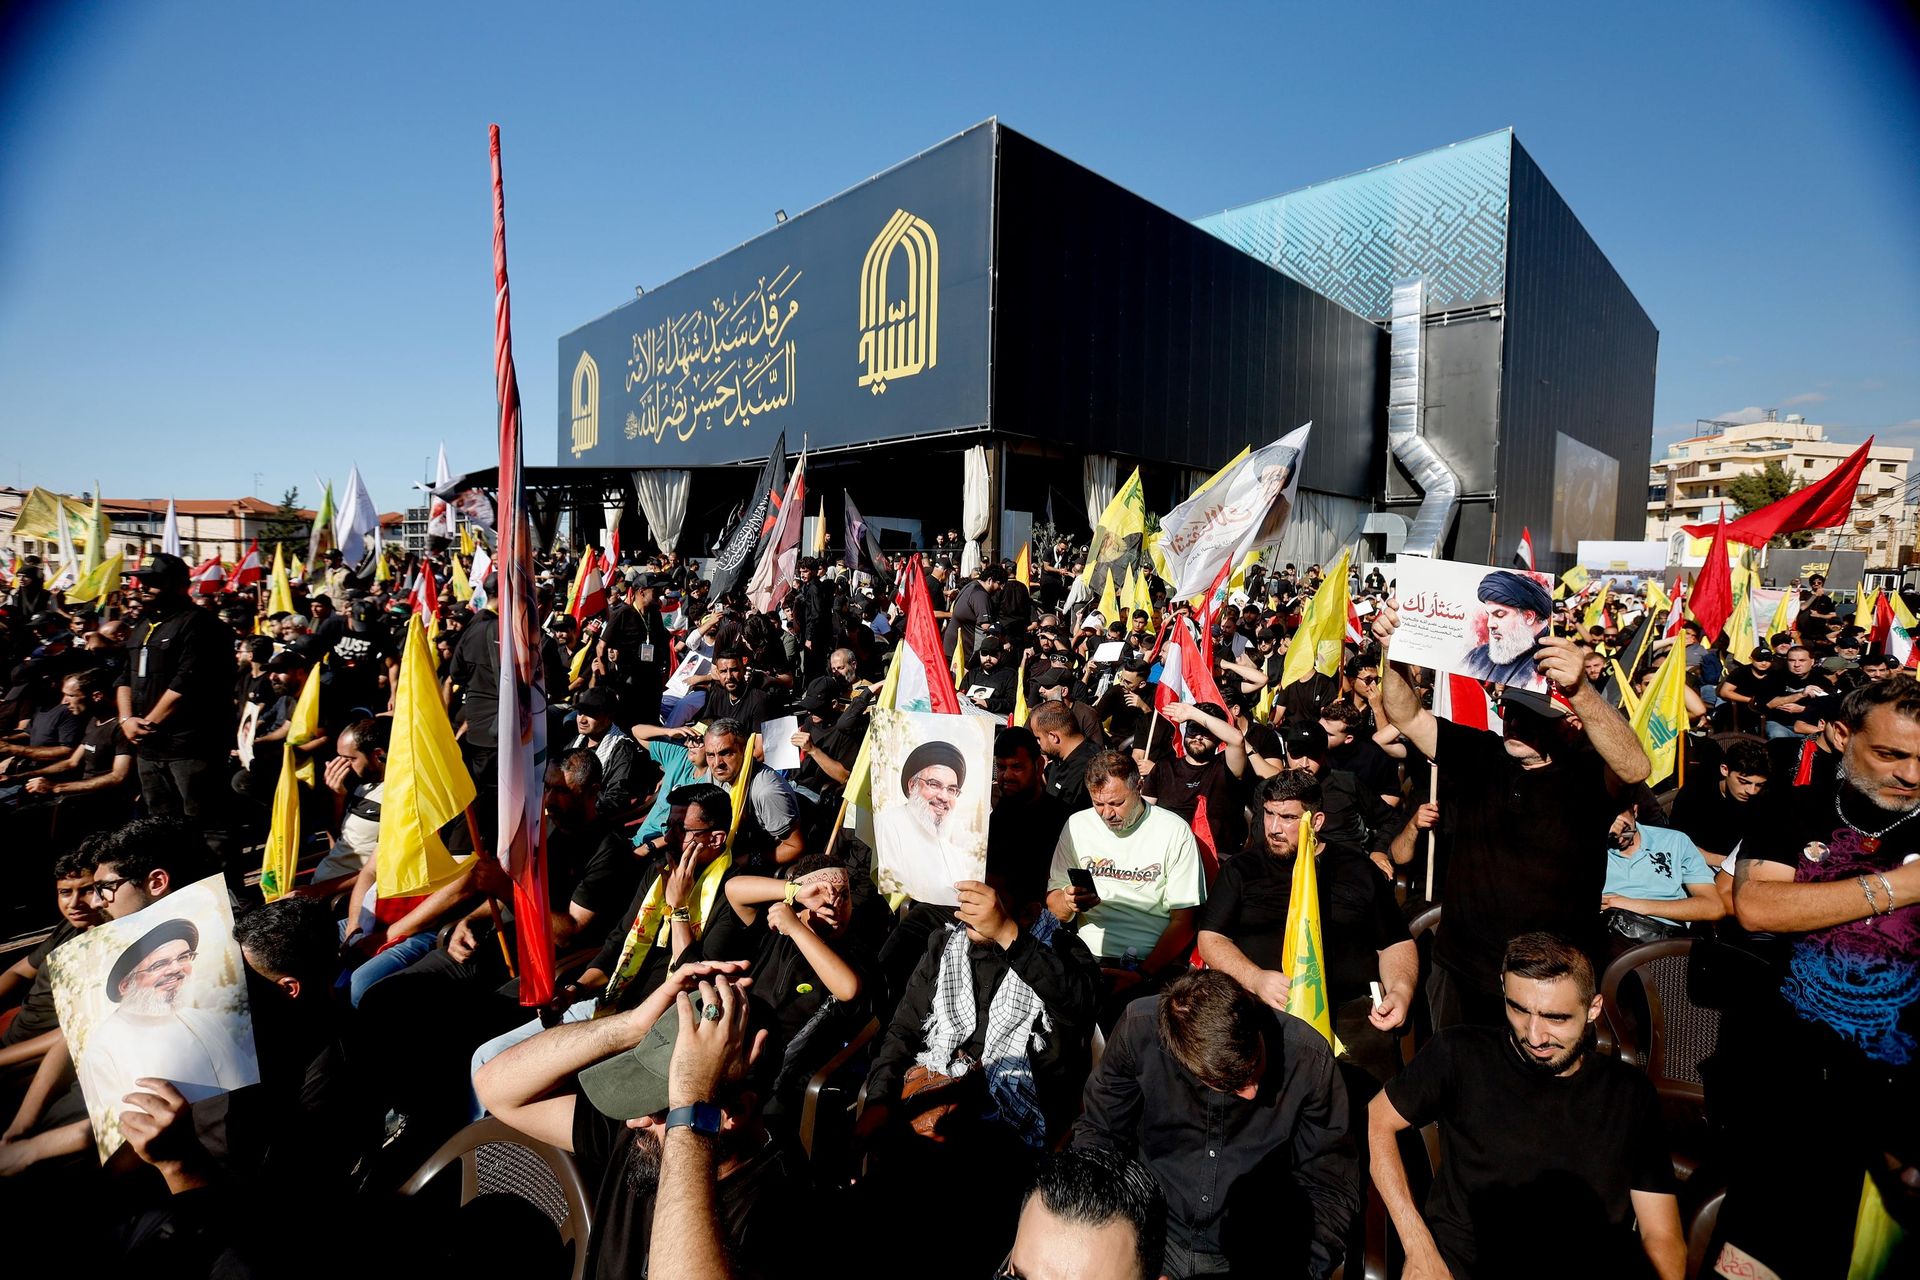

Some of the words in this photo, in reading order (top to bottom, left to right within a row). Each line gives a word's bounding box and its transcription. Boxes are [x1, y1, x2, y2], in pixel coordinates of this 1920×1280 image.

[750, 273, 802, 348] مرقد
[677, 374, 736, 442] حسن
[336, 636, 371, 652] JUST
[1086, 859, 1161, 882] Budweiser
